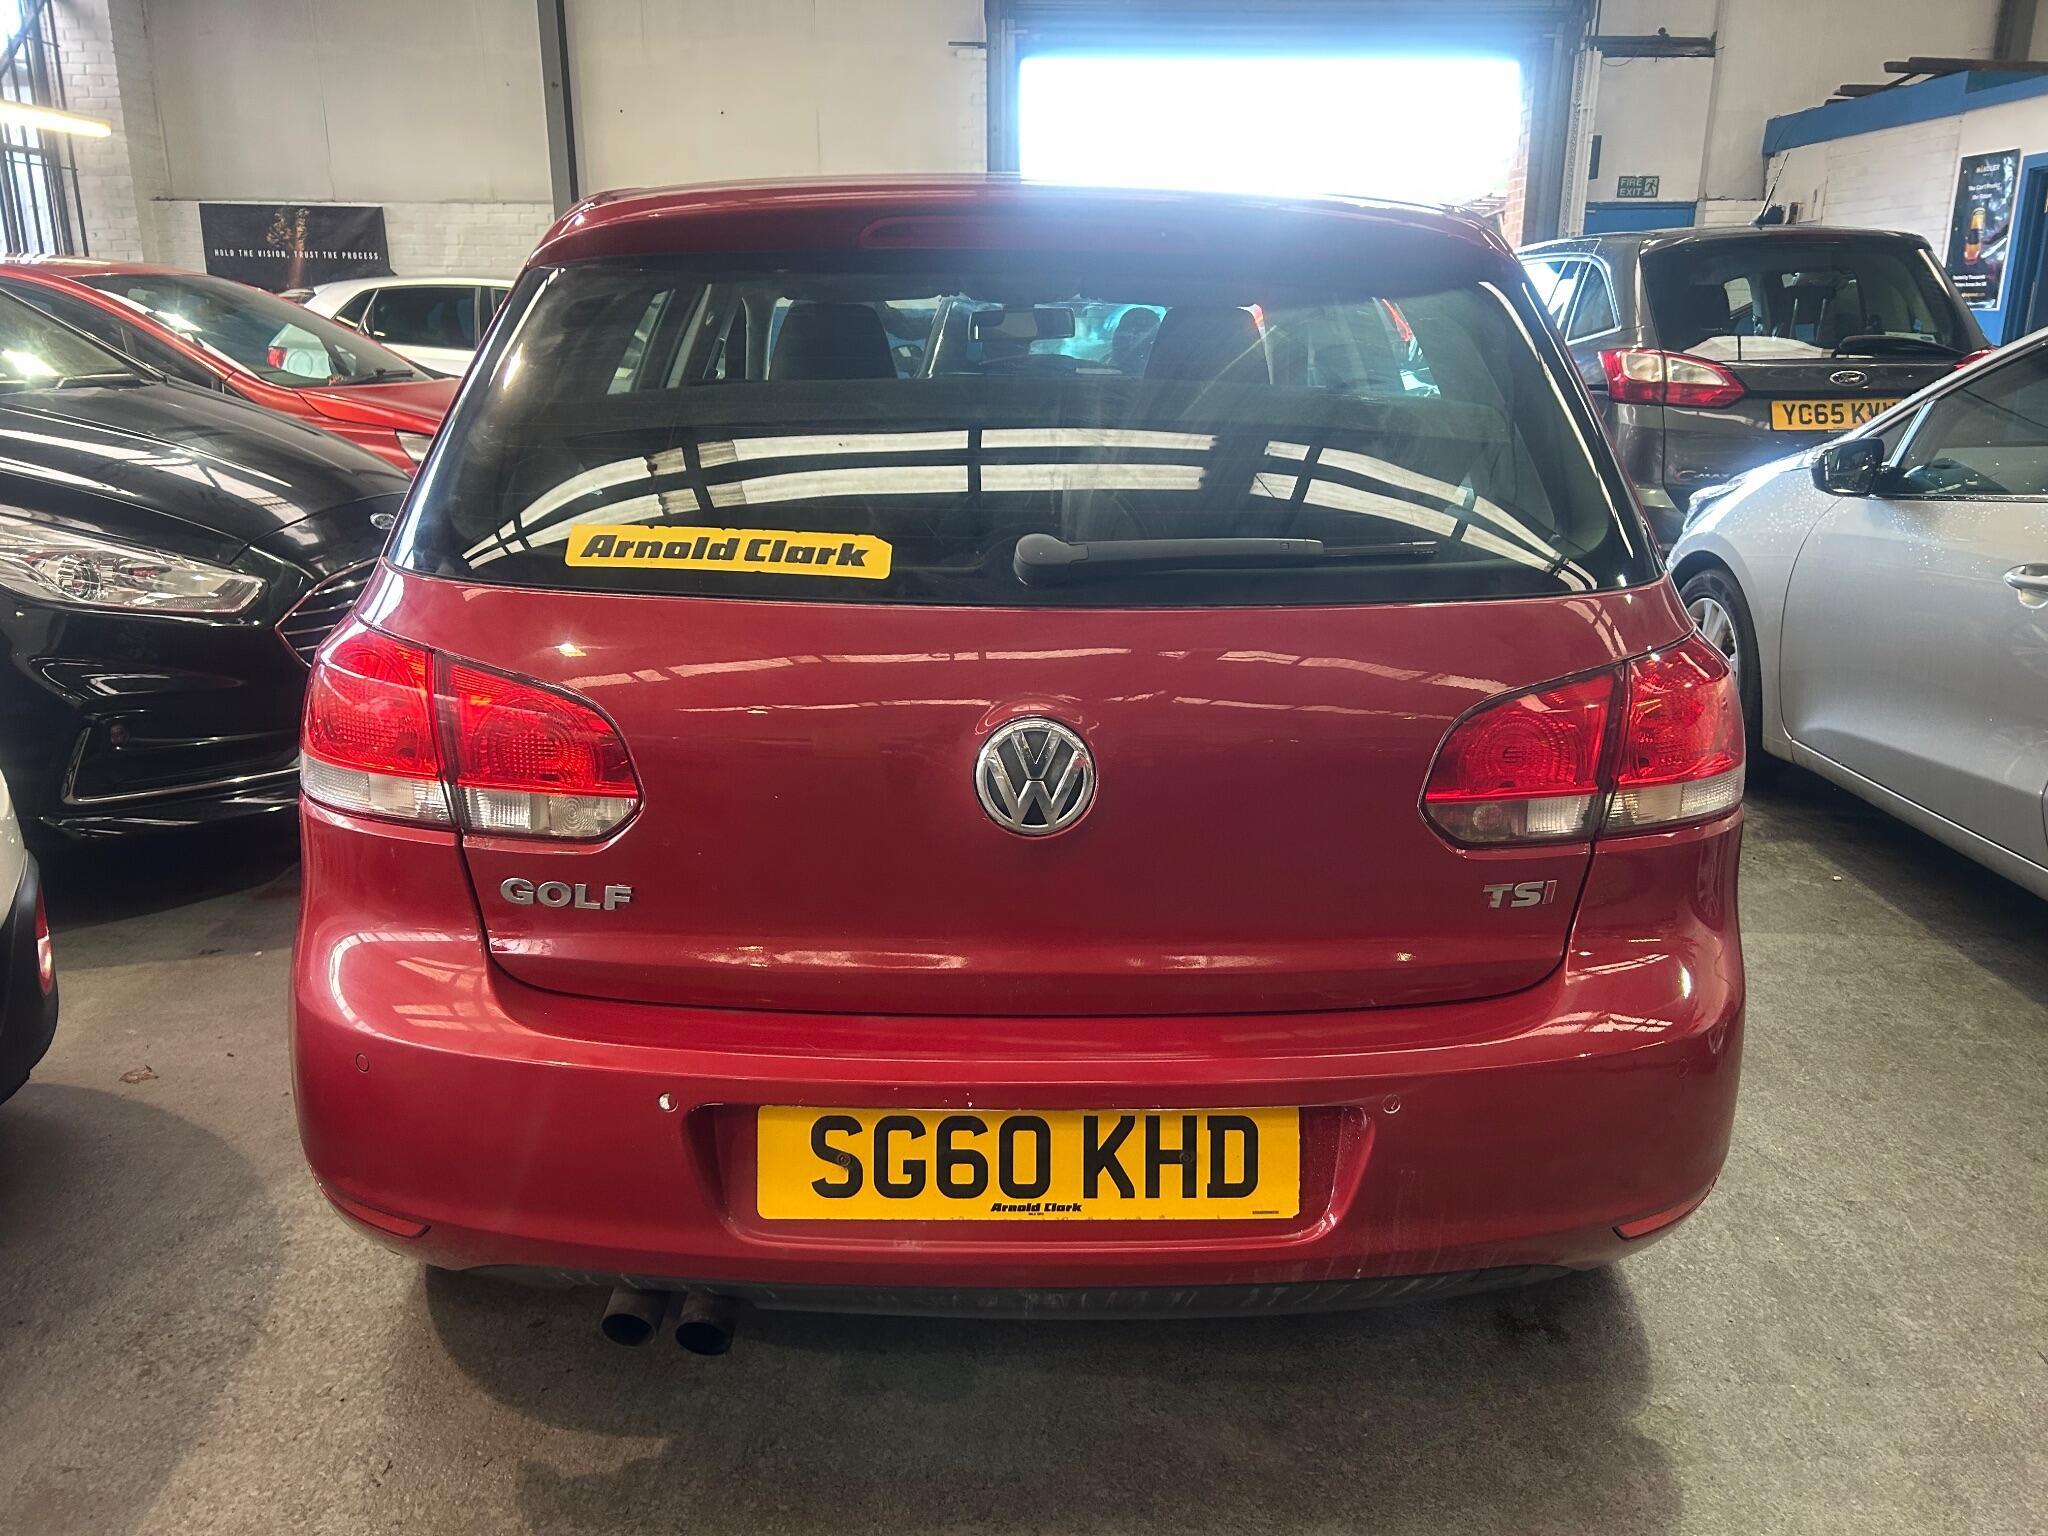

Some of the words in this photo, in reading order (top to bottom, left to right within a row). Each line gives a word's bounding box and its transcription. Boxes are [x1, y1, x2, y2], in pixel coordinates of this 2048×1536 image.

[1620, 177, 1643, 187] FIRE
[1619, 187, 1643, 197] EXIT
[214, 248, 235, 257] HOLD
[238, 249, 254, 258] THE
[293, 250, 319, 259] TRUST
[322, 251, 338, 260] THE
[1782, 403, 1845, 425] YC65
[579, 534, 740, 561] Arnold
[744, 538, 870, 567] Clark
[500, 877, 633, 911] GOLF
[811, 1115, 1052, 1199] SG60
[1083, 1115, 1259, 1199] KHD
[990, 1202, 1041, 1212] Arnold
[1044, 1202, 1082, 1212] Clark
